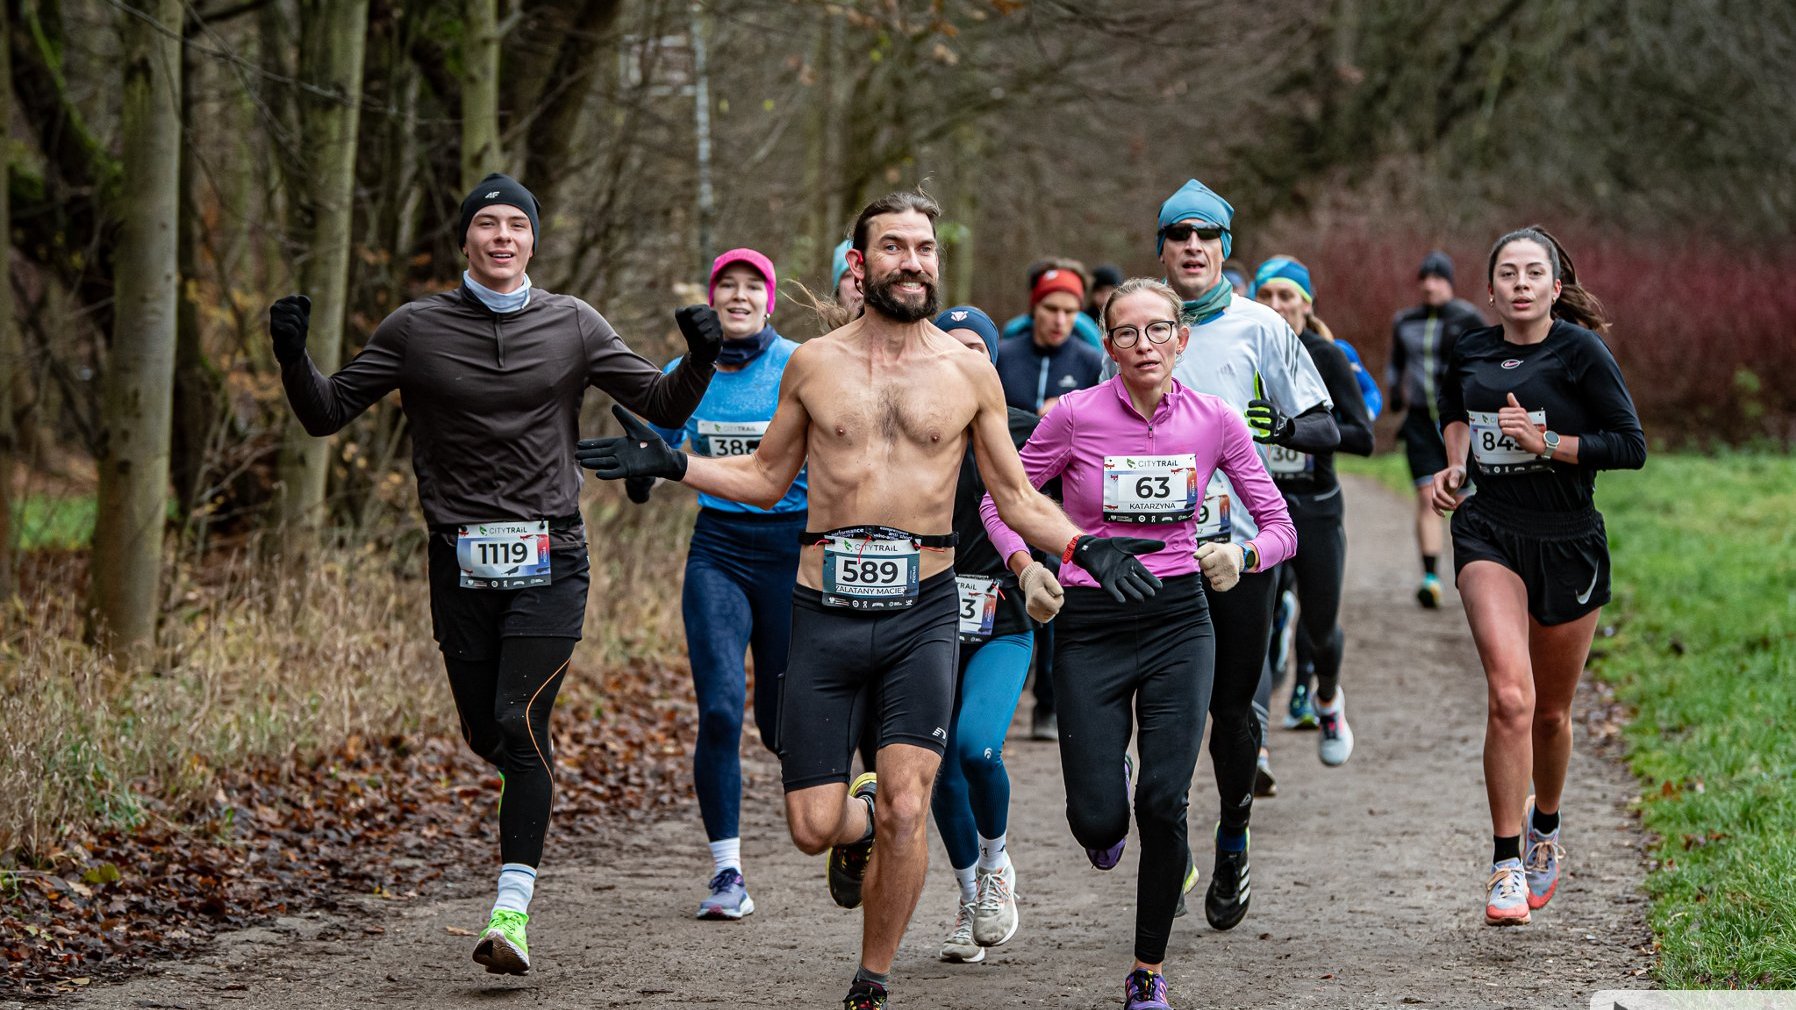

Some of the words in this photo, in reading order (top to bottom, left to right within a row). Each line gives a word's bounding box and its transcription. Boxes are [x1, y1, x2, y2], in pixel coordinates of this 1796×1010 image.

[1483, 431, 1524, 451] 84
[1136, 476, 1170, 499] 63
[1129, 502, 1176, 510] KATARZYNA
[1197, 505, 1209, 524] 9
[478, 542, 528, 565] 1119
[855, 543, 898, 552] CTYTRAiL
[842, 559, 898, 584] 589
[836, 585, 874, 595] ZALATANY
[960, 598, 976, 619] 3
